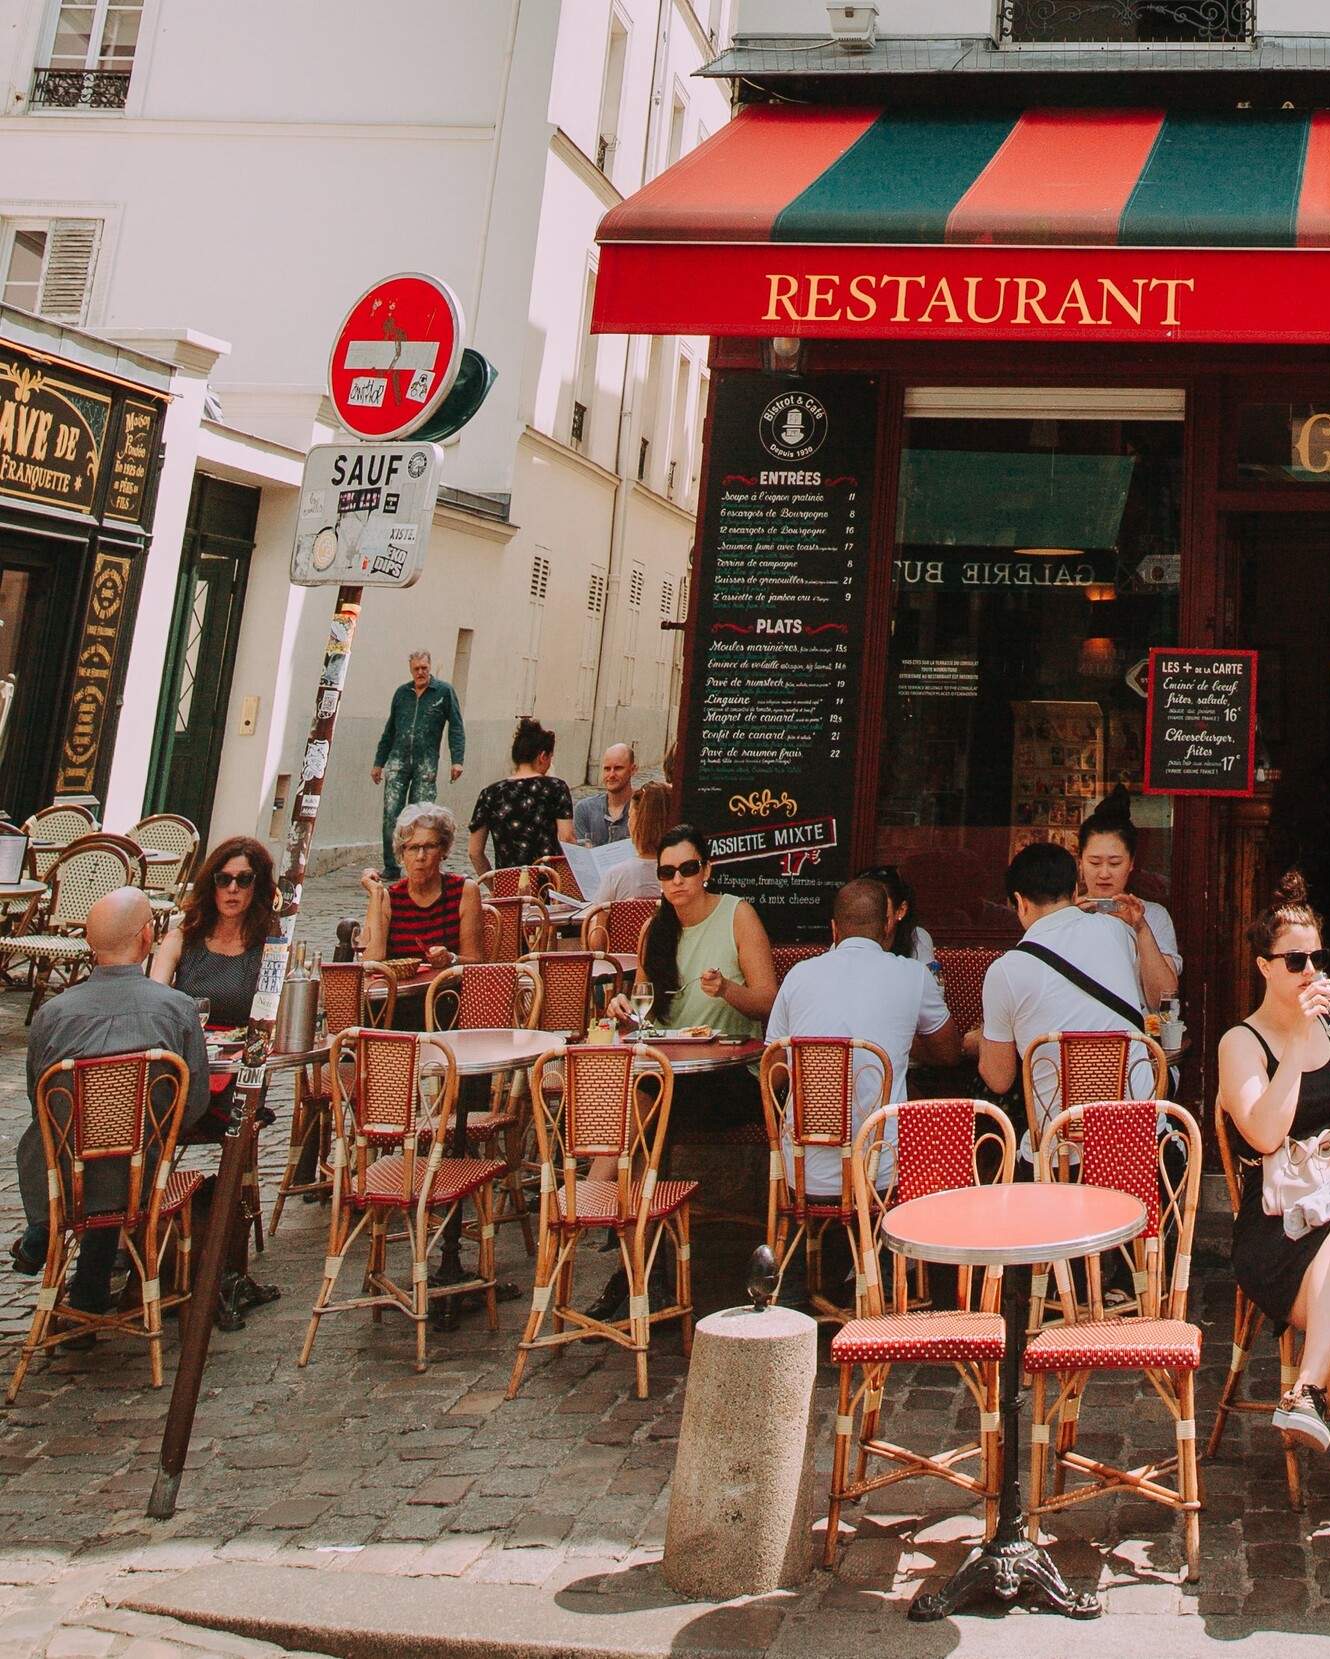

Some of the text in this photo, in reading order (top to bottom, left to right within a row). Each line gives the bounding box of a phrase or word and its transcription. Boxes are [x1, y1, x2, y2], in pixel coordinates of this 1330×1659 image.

[761, 274, 1195, 326] RESTAURANT
[764, 395, 825, 422] Bistrot & Café
[125, 412, 151, 433] Maison
[0, 400, 80, 461] AVE DE
[117, 433, 147, 459] Fondée
[770, 443, 813, 458] Depuis 1930
[0, 453, 71, 493] FRANQUETTE
[122, 461, 136, 477] 1925
[136, 465, 145, 478] de
[331, 454, 403, 487] SAUF
[760, 470, 822, 485] ENTRÉES
[721, 491, 749, 503] Soupe
[751, 491, 757, 501] à
[759, 491, 790, 503] l'oignon
[792, 492, 824, 504] gratinée
[720, 508, 856, 520] 6 escargots de Bourgogne 8
[719, 525, 855, 537] 12 escargots de Bourgogne 16
[717, 542, 753, 551] Saumon
[755, 542, 774, 553] fumé
[844, 543, 854, 551] 17
[372, 556, 402, 579] DIPS
[717, 559, 745, 567] Terrine
[747, 559, 757, 567] de
[759, 561, 798, 569] campagne
[714, 575, 745, 584] Cuisses
[747, 575, 758, 584] de
[760, 575, 805, 586] grenouilles
[755, 593, 766, 601] de
[768, 593, 795, 604] jambon
[845, 593, 851, 601] 9
[756, 619, 802, 634] PLATS
[1162, 662, 1180, 673] LES
[1183, 663, 1192, 673] +
[1212, 663, 1243, 675] CARTE
[705, 677, 728, 687] Pavé
[730, 677, 742, 687] de
[703, 711, 741, 724] Magret
[744, 712, 757, 722] de
[760, 712, 795, 722] canard
[702, 730, 730, 742] Confit
[732, 730, 745, 740] de
[748, 730, 785, 740] canard
[1184, 744, 1212, 759] frites
[707, 823, 824, 857] 'ASSIETTE MIXTE
[759, 893, 820, 905] & mix cheese
